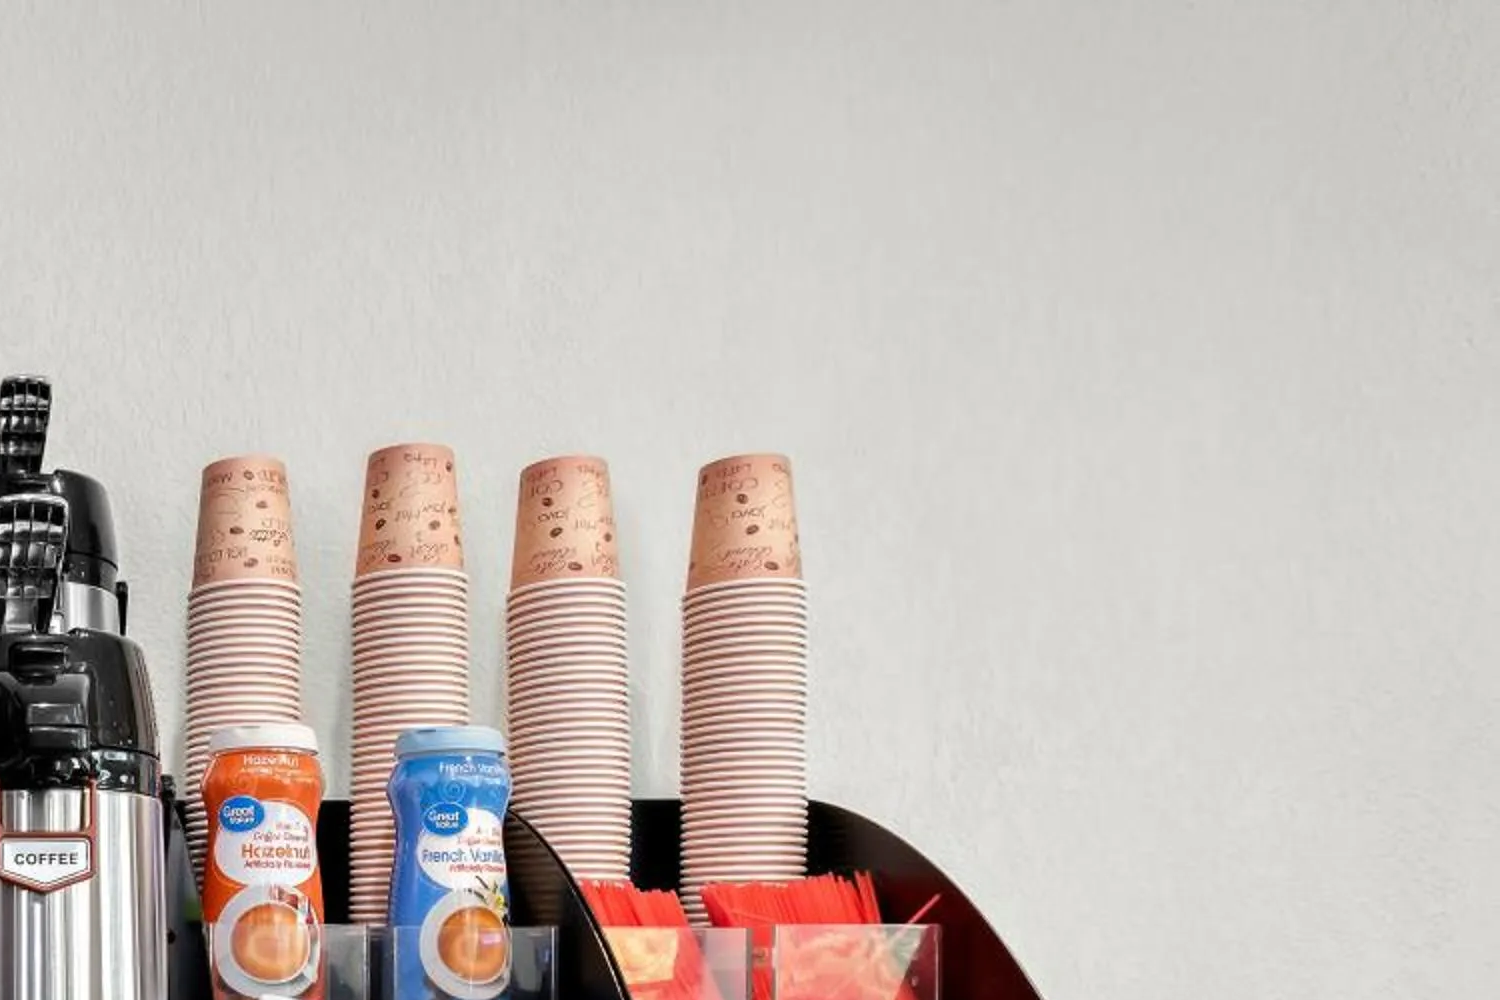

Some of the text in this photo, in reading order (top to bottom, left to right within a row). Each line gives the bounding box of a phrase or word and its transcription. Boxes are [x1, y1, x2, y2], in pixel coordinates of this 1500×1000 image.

[223, 805, 255, 818] Great
[427, 809, 460, 822] Great
[241, 844, 311, 859] Hazelnut
[422, 848, 467, 863] French
[14, 852, 79, 865] COFFEE
